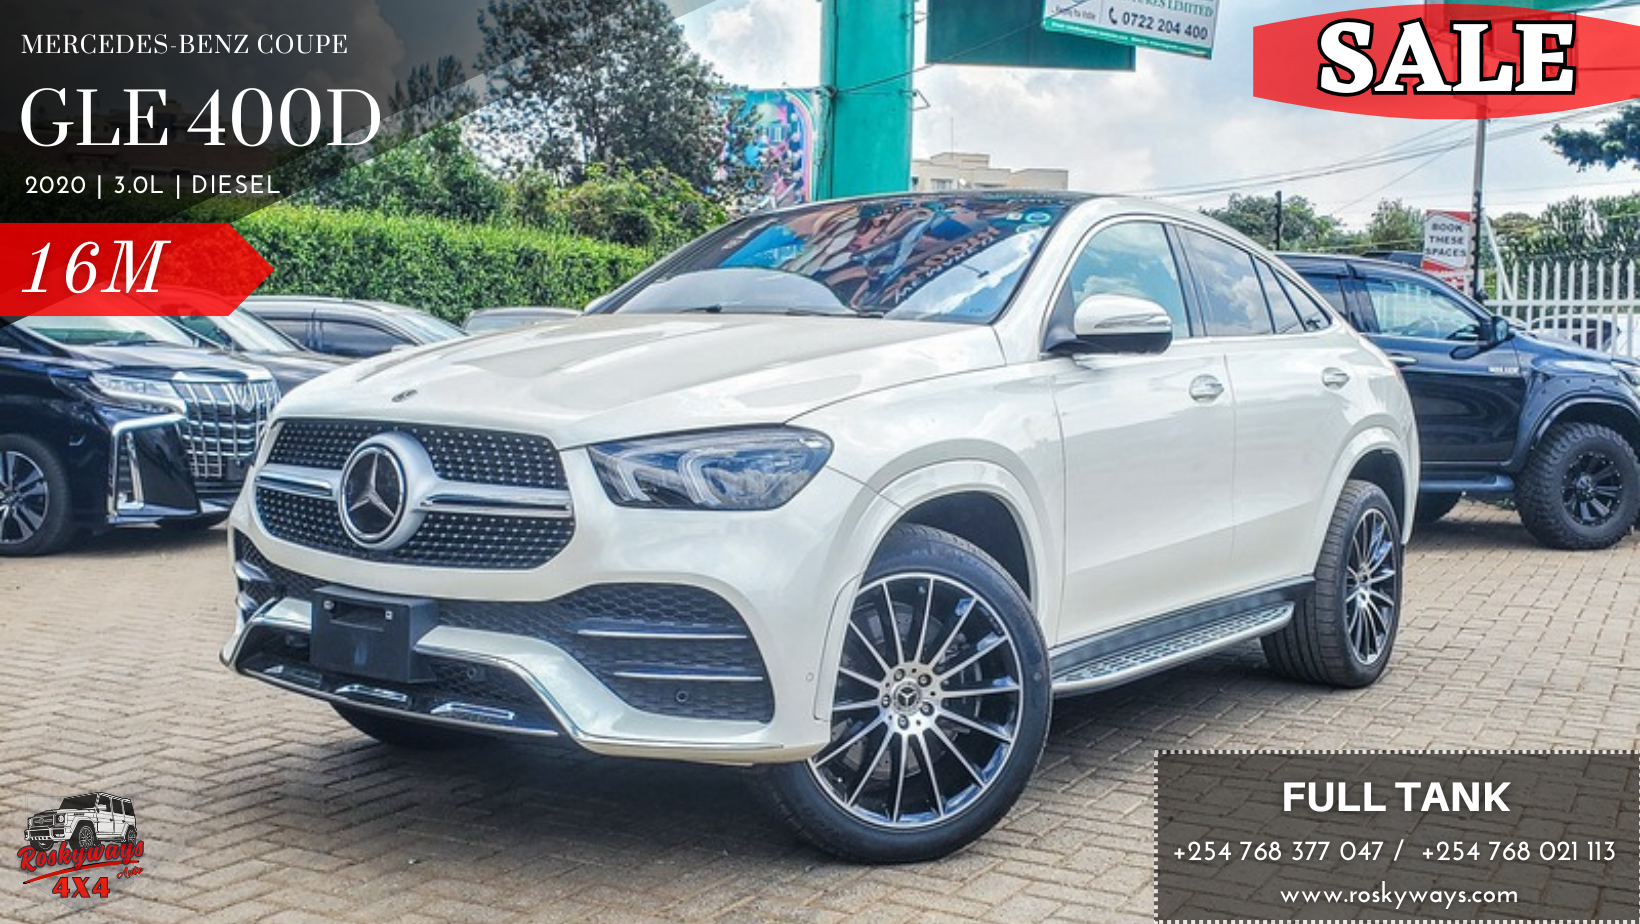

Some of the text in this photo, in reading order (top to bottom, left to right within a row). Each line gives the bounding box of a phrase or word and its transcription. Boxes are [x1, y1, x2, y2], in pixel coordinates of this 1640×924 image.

[1122, 11, 1208, 40] 0722 204 400
[1431, 223, 1462, 232] BOOK
[1429, 236, 1464, 244] THESE
[1425, 248, 1466, 257] SPACES
